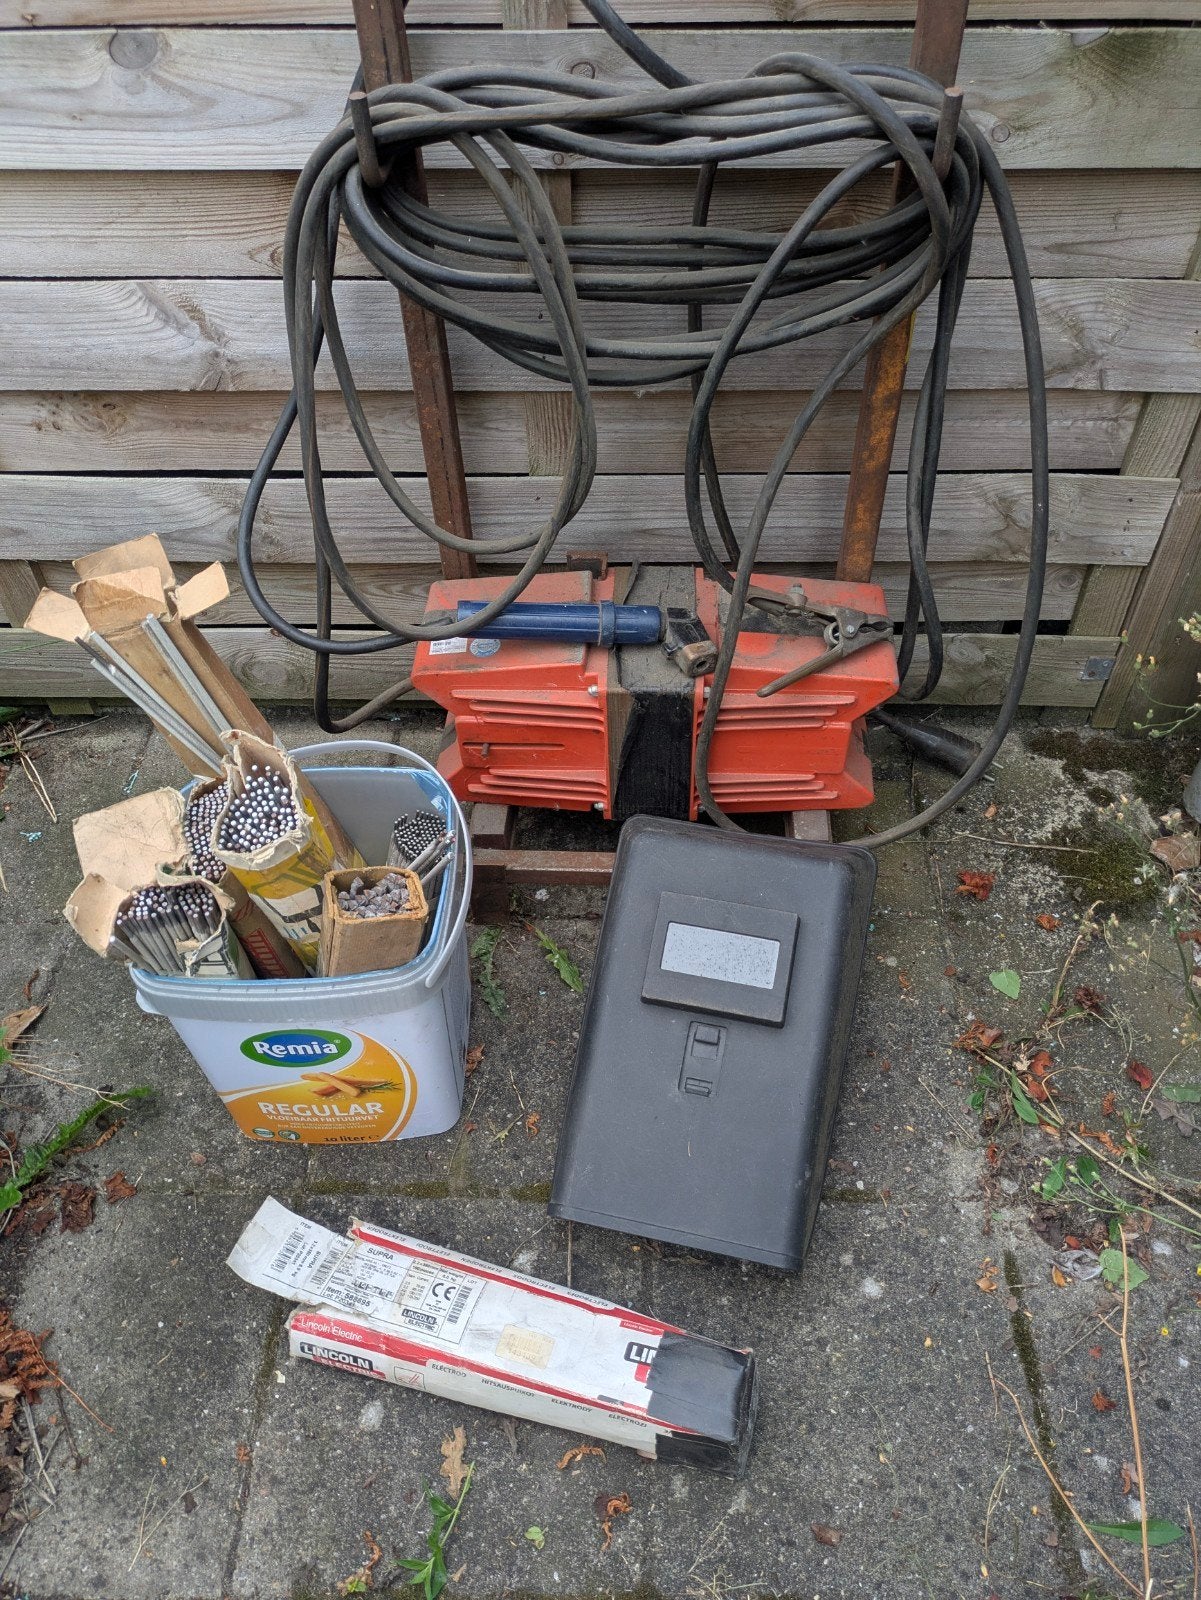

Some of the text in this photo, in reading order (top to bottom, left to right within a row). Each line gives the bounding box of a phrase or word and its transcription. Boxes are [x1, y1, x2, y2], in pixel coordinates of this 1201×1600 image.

[252, 1041, 339, 1058] Remia
[257, 1101, 384, 1117] REGULAR
[266, 1114, 379, 1123] VLOEIBAAR FRITUURVET
[367, 1247, 394, 1261] SUPRA
[300, 1317, 363, 1342] Lincoln Electric
[304, 1344, 370, 1369] LINCOLN
